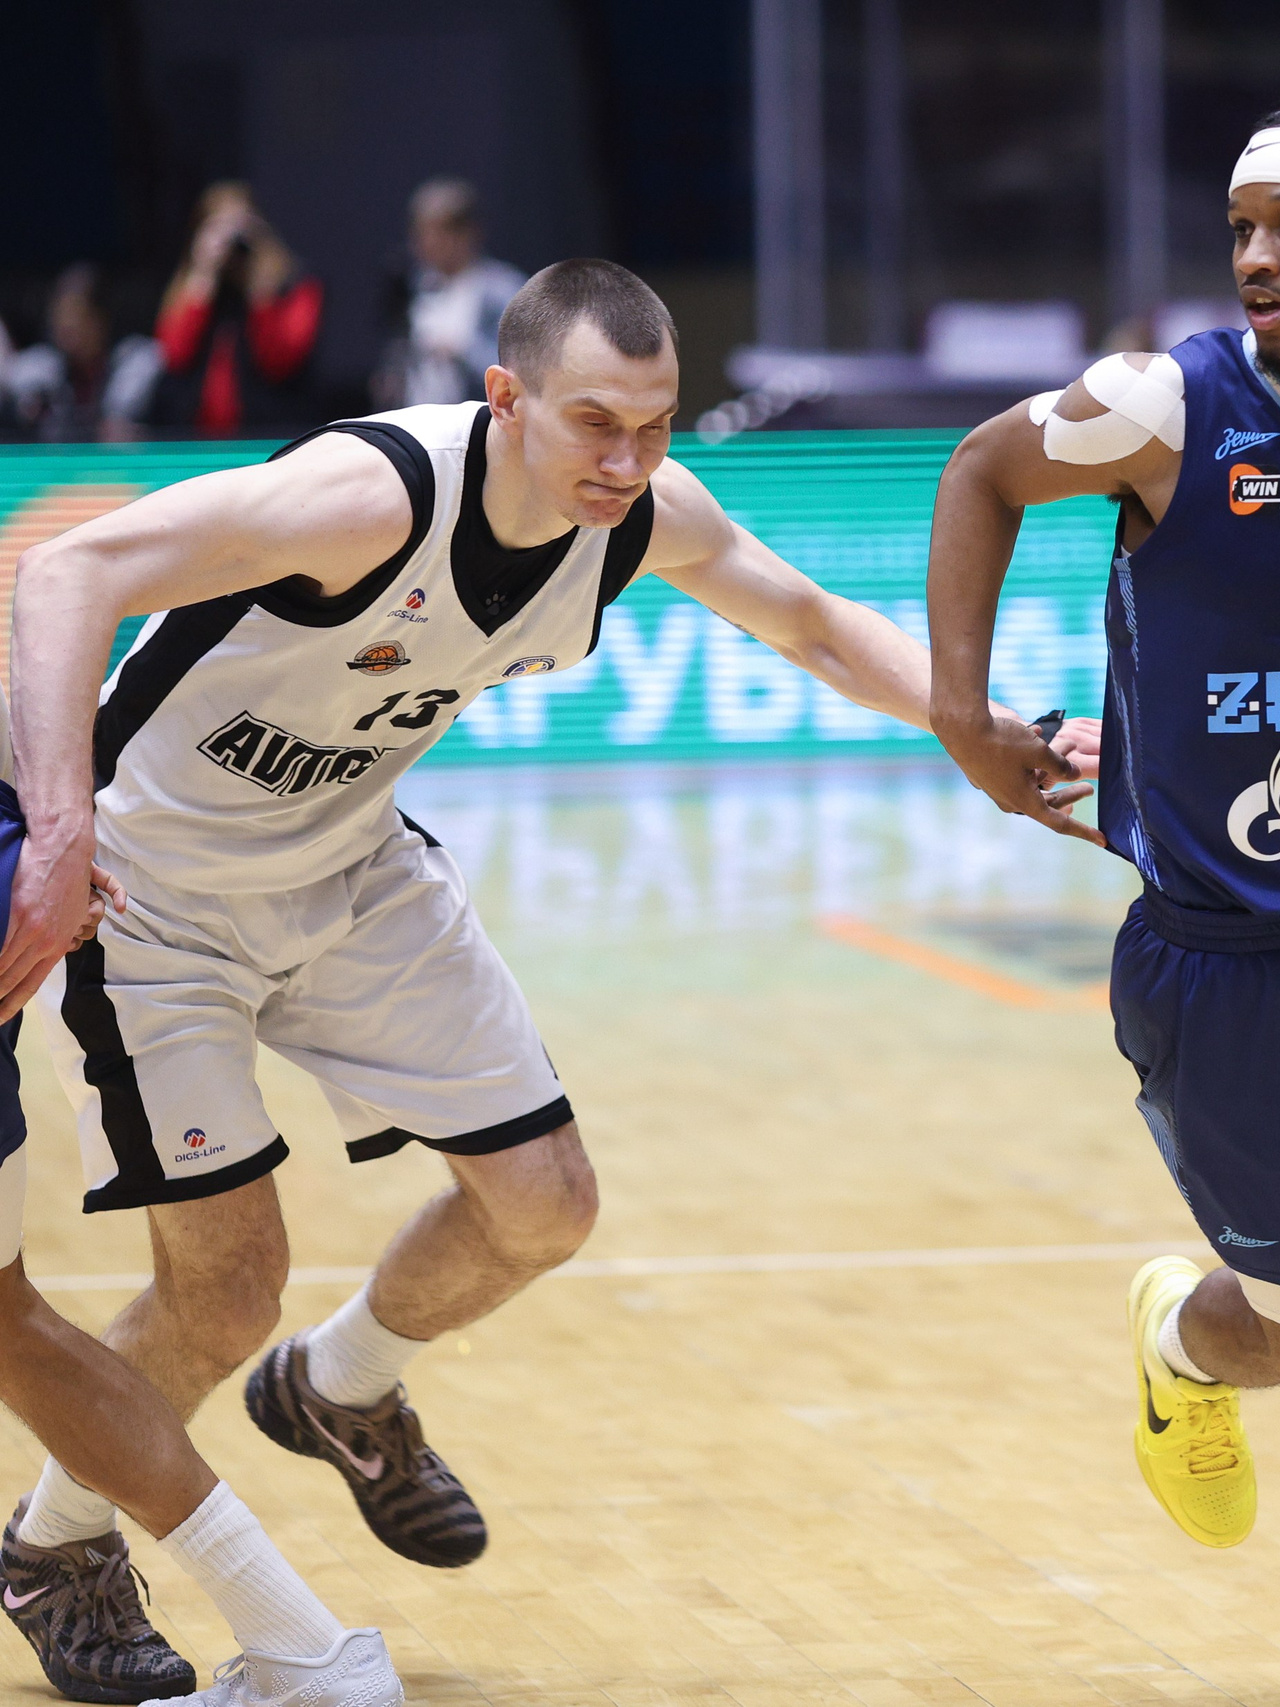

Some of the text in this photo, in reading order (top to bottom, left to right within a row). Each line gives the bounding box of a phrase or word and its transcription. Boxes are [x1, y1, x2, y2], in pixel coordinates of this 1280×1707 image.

[1242, 481, 1279, 497] WIN
[353, 689, 461, 731] 13
[174, 1144, 227, 1163] DIGS-Line
